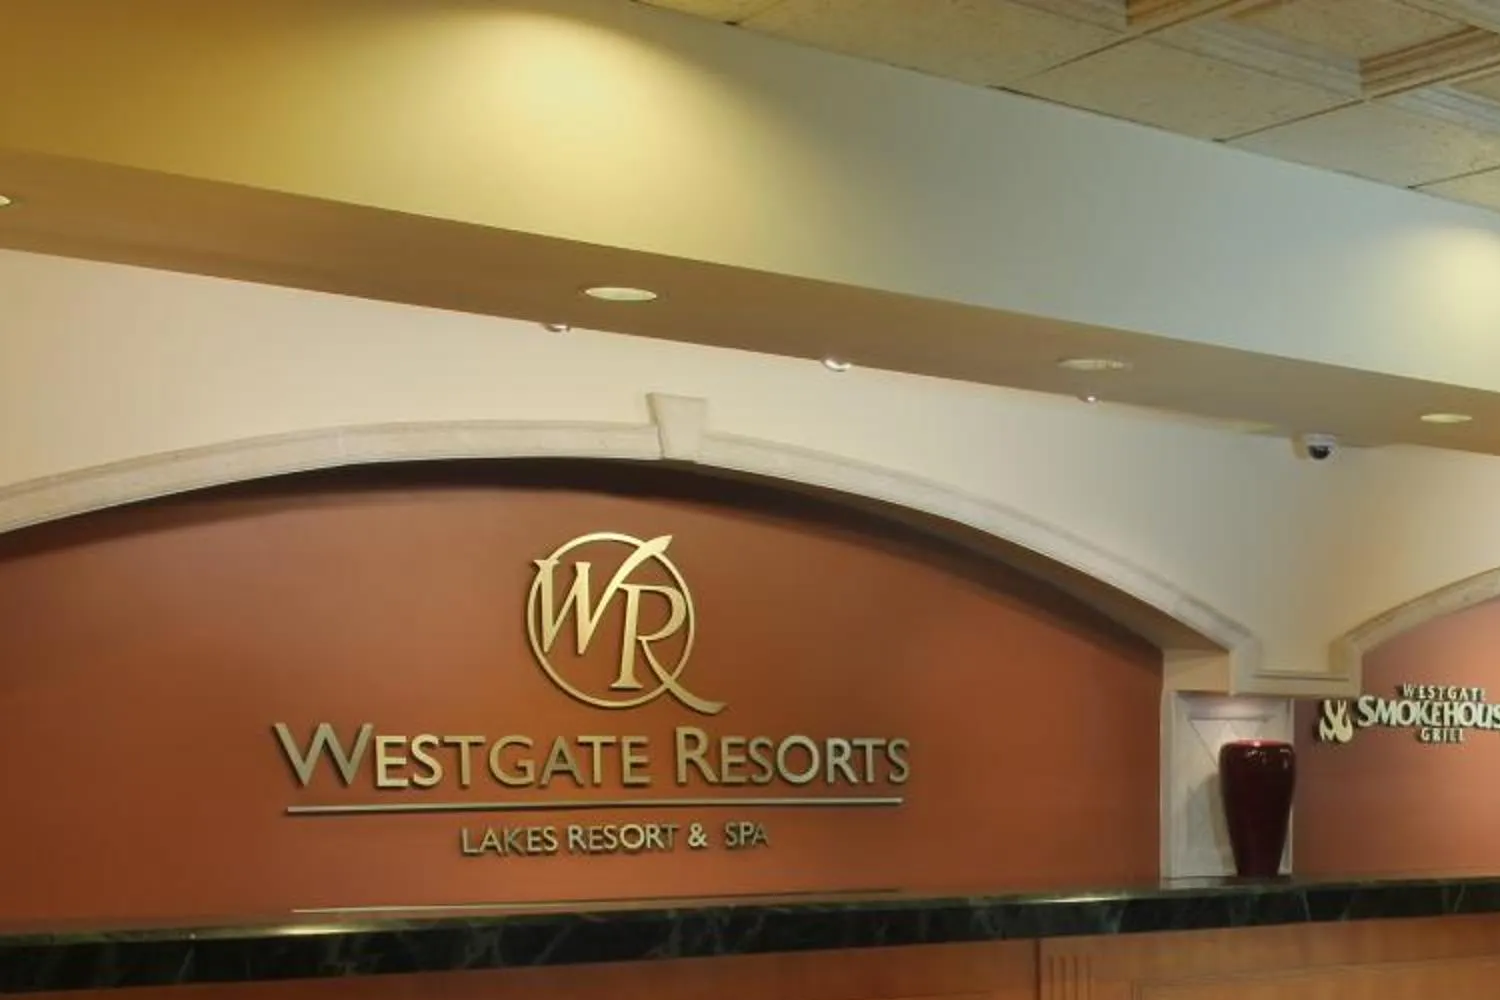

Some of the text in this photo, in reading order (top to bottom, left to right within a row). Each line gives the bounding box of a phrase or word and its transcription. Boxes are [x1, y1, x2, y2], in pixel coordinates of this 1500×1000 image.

[1402, 683, 1487, 702] WESTGATE
[1420, 726, 1466, 743] GRILL
[274, 722, 911, 790] WESTGATE RESORTS
[460, 821, 769, 854] LAKES RESORT & SPA
